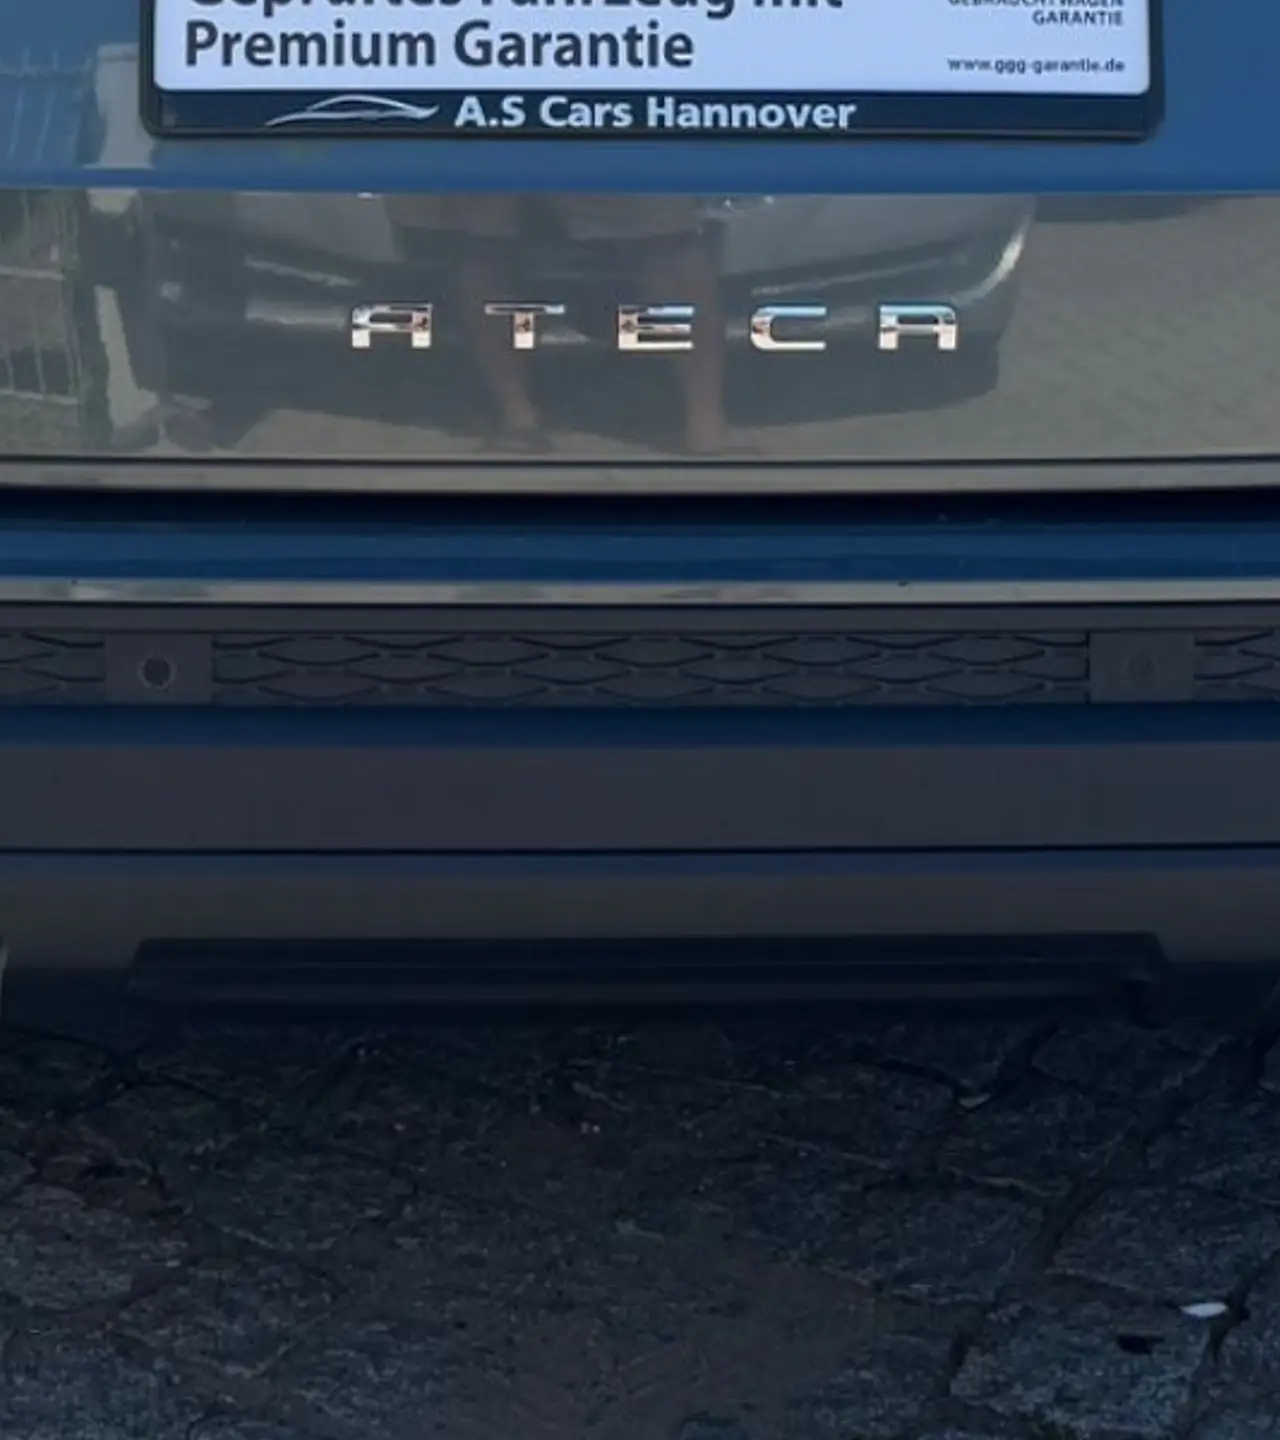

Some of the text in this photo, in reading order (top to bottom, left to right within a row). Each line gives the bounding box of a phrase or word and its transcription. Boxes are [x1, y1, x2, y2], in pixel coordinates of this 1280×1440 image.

[1031, 9, 1124, 27] GARANTIE
[185, 17, 695, 68] Premium Garantie
[946, 57, 1127, 75] www.ggg-garantie.de
[454, 95, 858, 130] A.S Cars Hannover
[351, 302, 957, 350] ATECA
